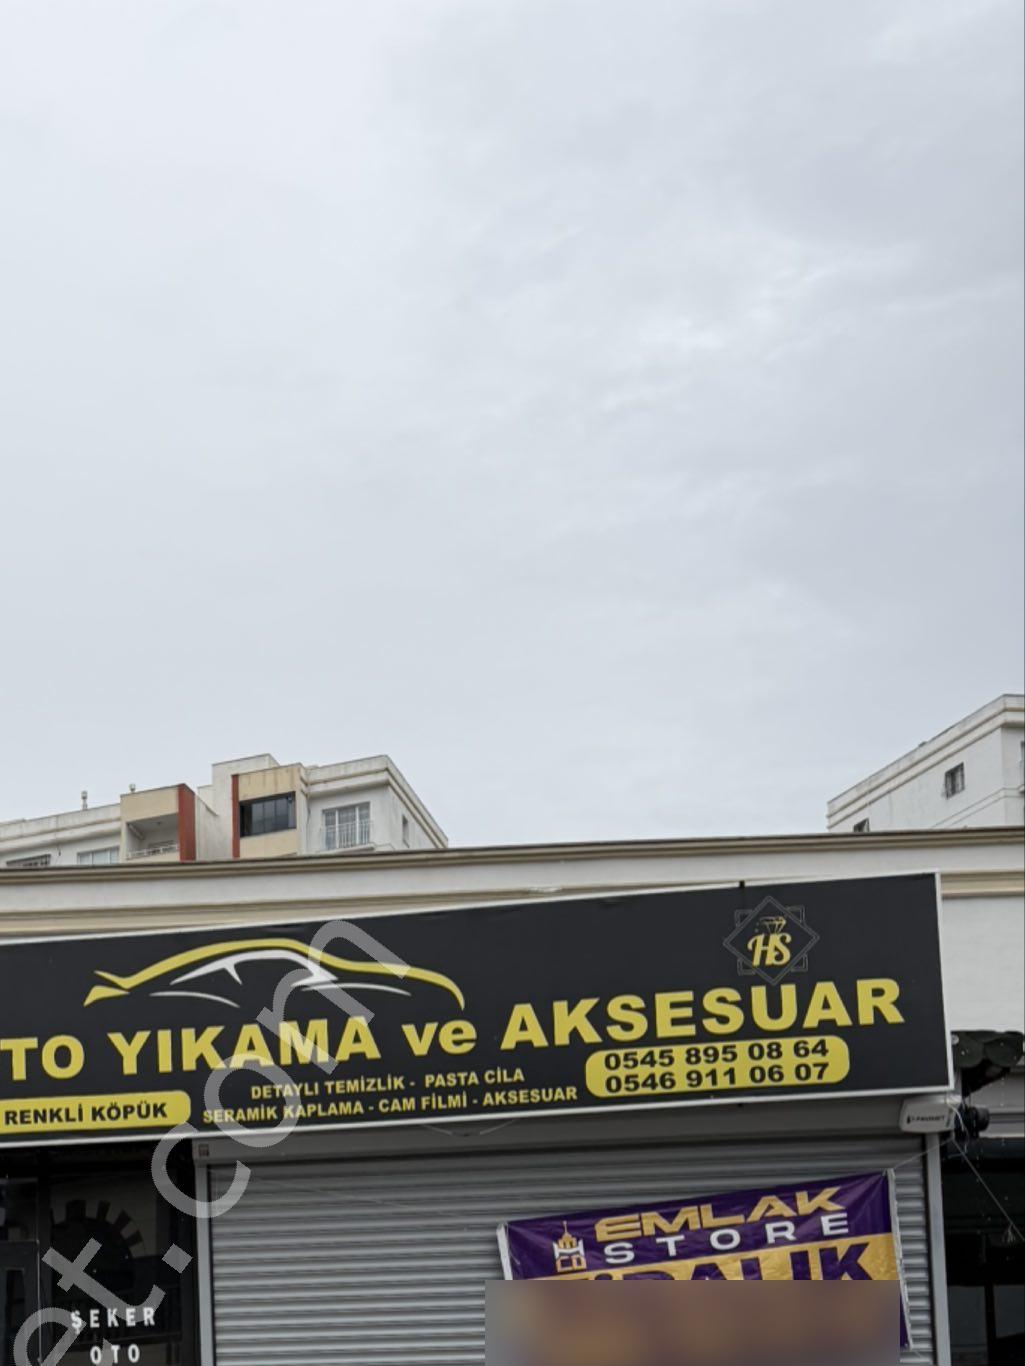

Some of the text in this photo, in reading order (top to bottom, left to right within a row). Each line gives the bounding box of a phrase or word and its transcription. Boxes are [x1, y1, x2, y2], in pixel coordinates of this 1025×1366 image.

[108, 1016, 381, 1074] YIKAMA
[401, 1018, 477, 1057] ve
[501, 978, 905, 1051] AKSESUAR
[604, 1039, 829, 1071] 0545 895 08 64
[251, 1082, 319, 1100] DETAYLI
[324, 1073, 405, 1095] TEMİZLİK
[425, 1071, 479, 1088] PASTA
[484, 1066, 525, 1083] CİLA
[605, 1062, 830, 1095] 0546 911 06 07
[4, 1097, 168, 1126] RENKLİ KÖPÜK
[203, 1104, 277, 1123] SERAMİK
[284, 1101, 364, 1119] KAPLAMA
[378, 1097, 415, 1113] CAM
[421, 1091, 467, 1110] FİLMİ
[483, 1086, 578, 1106] AKSESUAR
[594, 1186, 847, 1242] EMLAK
[604, 1212, 849, 1265] STORE
[90, 1344, 140, 1364] OTO
